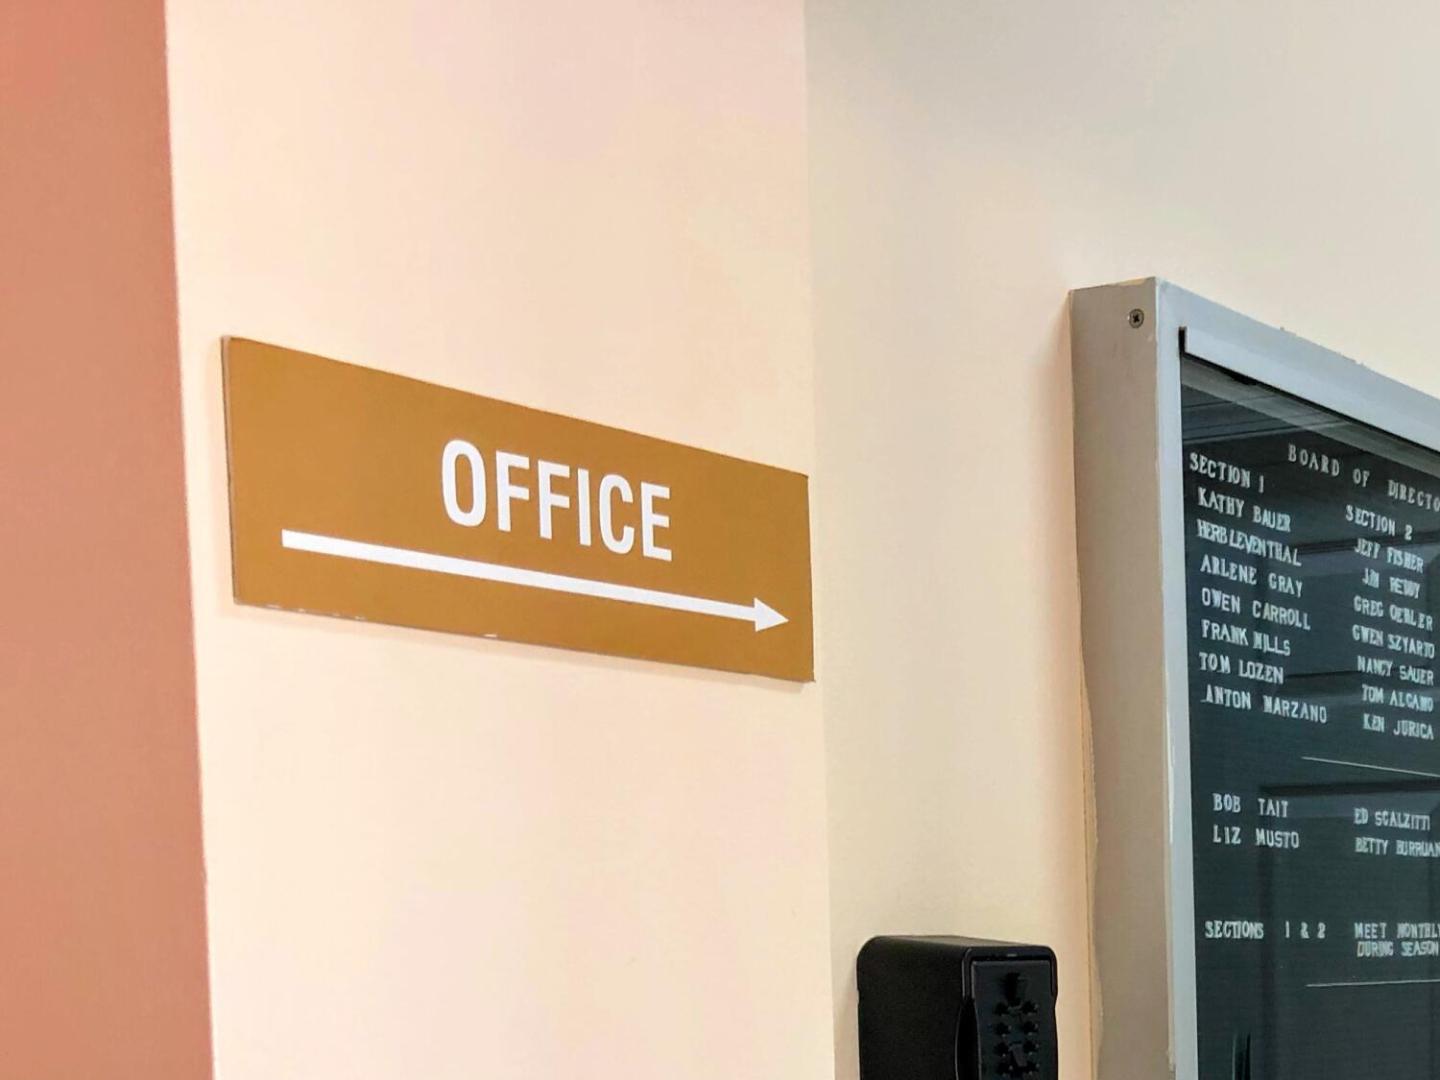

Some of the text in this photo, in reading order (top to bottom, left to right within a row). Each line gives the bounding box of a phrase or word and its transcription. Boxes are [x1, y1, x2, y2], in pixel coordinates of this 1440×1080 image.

[1189, 452, 1264, 493] SECTION 1
[1288, 444, 1340, 477] BOARD
[1352, 468, 1370, 488] OF
[441, 439, 673, 562] OFFICE
[1197, 486, 1291, 532] KATHY BAUER
[1345, 504, 1413, 541] SECTION 2
[1197, 518, 1302, 567] HERB LEVENTHAL
[1354, 538, 1424, 574] JEFF FISHER
[1200, 554, 1303, 598] ARLENE GRAY
[1202, 587, 1311, 630] OWEN CARROLL
[1353, 595, 1384, 618] GREG
[1201, 619, 1292, 657] FRANK MILLS
[1352, 624, 1384, 646] GWEN
[1199, 652, 1284, 685] TOM LOZEN
[1357, 655, 1435, 686] NANCY SAUER
[1205, 684, 1327, 724] ANTON MARZANO
[1362, 684, 1384, 704] TOM
[1363, 714, 1435, 740] KEN JURICA
[1212, 793, 1289, 818] BOB TAIT
[1354, 807, 1369, 825] ED
[1212, 825, 1300, 849] LIZ MUSTO
[1355, 837, 1389, 856] BETTY
[1204, 920, 1265, 940] SECTIONS
[1300, 921, 1310, 939] &
[1317, 921, 1327, 939] 2
[1354, 922, 1387, 939] MEET
[1357, 940, 1439, 958] DURING SEASON
